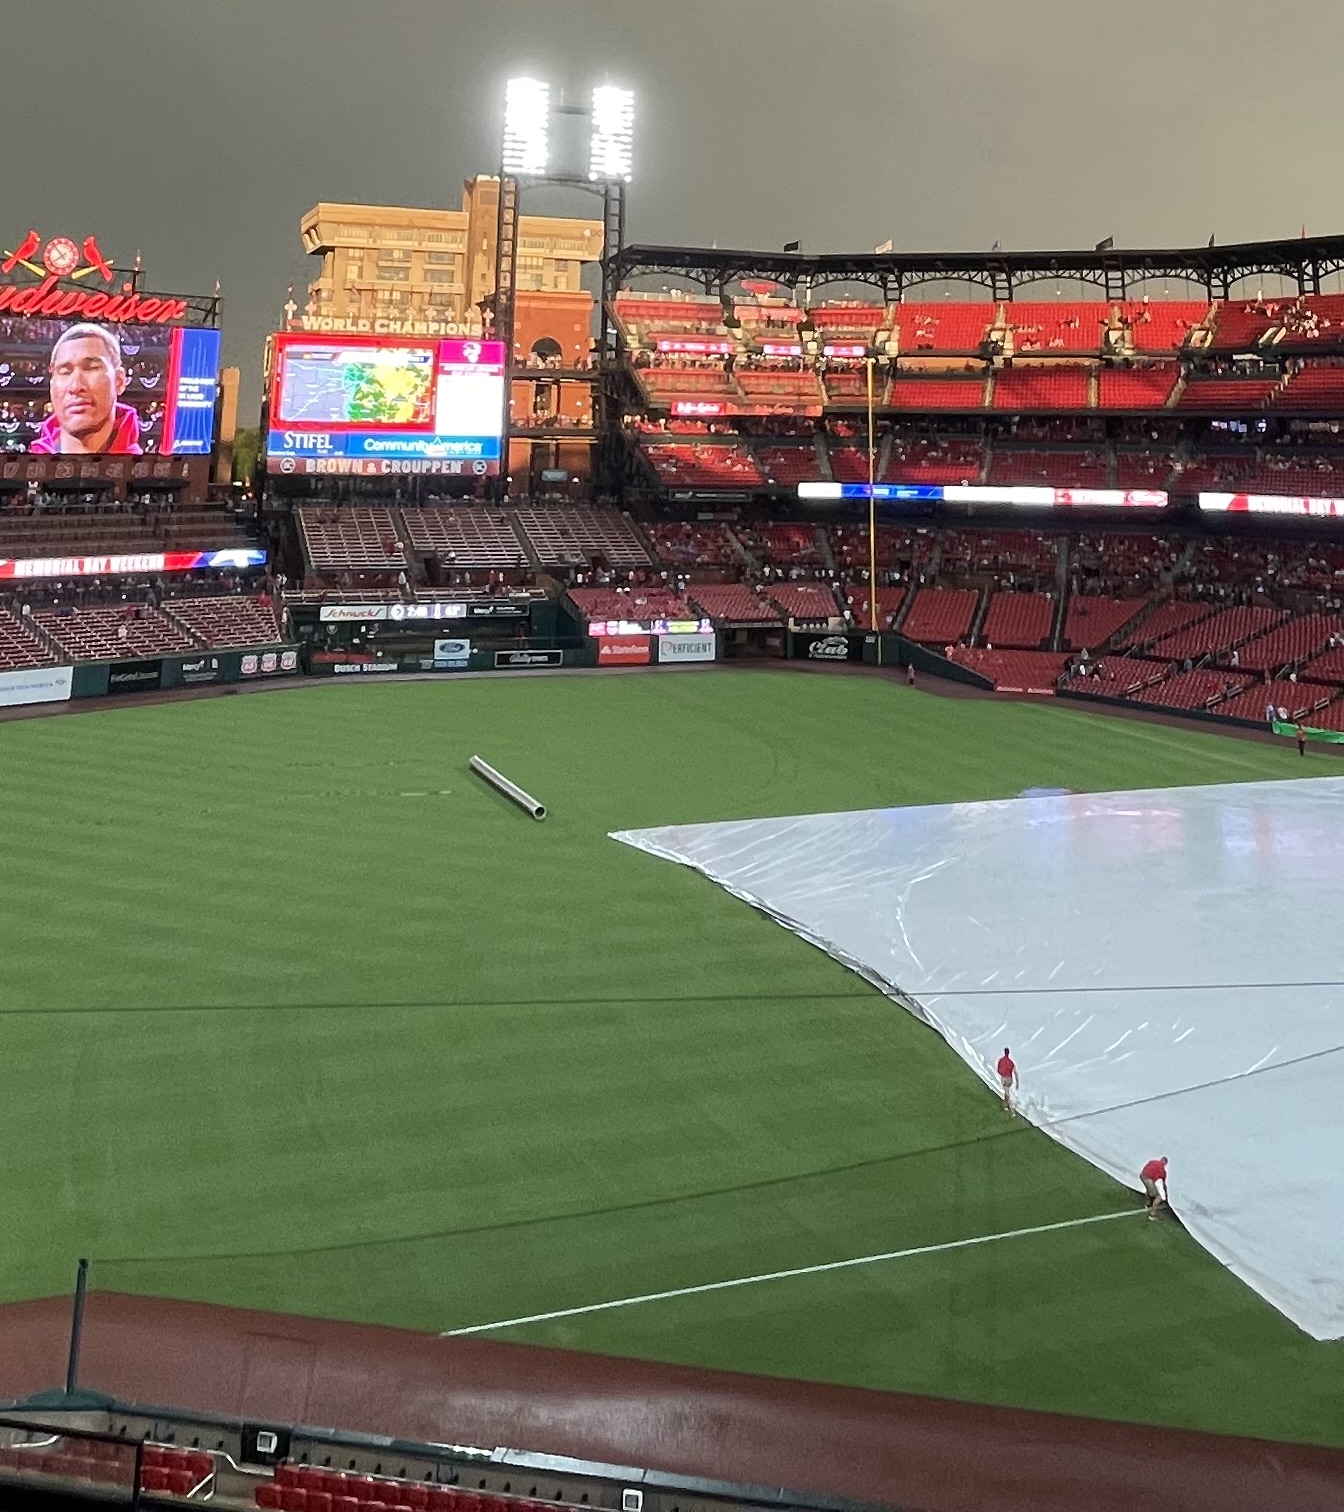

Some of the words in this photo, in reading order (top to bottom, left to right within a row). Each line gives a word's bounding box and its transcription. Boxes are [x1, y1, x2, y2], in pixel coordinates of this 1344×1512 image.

[302, 315, 372, 332] WORLD
[375, 318, 483, 337] CHAMPIONS
[283, 431, 334, 449] STIFEL
[3, 462, 20, 479] 17
[55, 462, 74, 479] 23
[306, 458, 363, 473] BROWN
[367, 462, 377, 473] &
[381, 460, 462, 474] CROUPPEN
[325, 608, 382, 618] Schnucks
[661, 640, 712, 657] PERFICIENT
[334, 664, 360, 673] BUSCH
